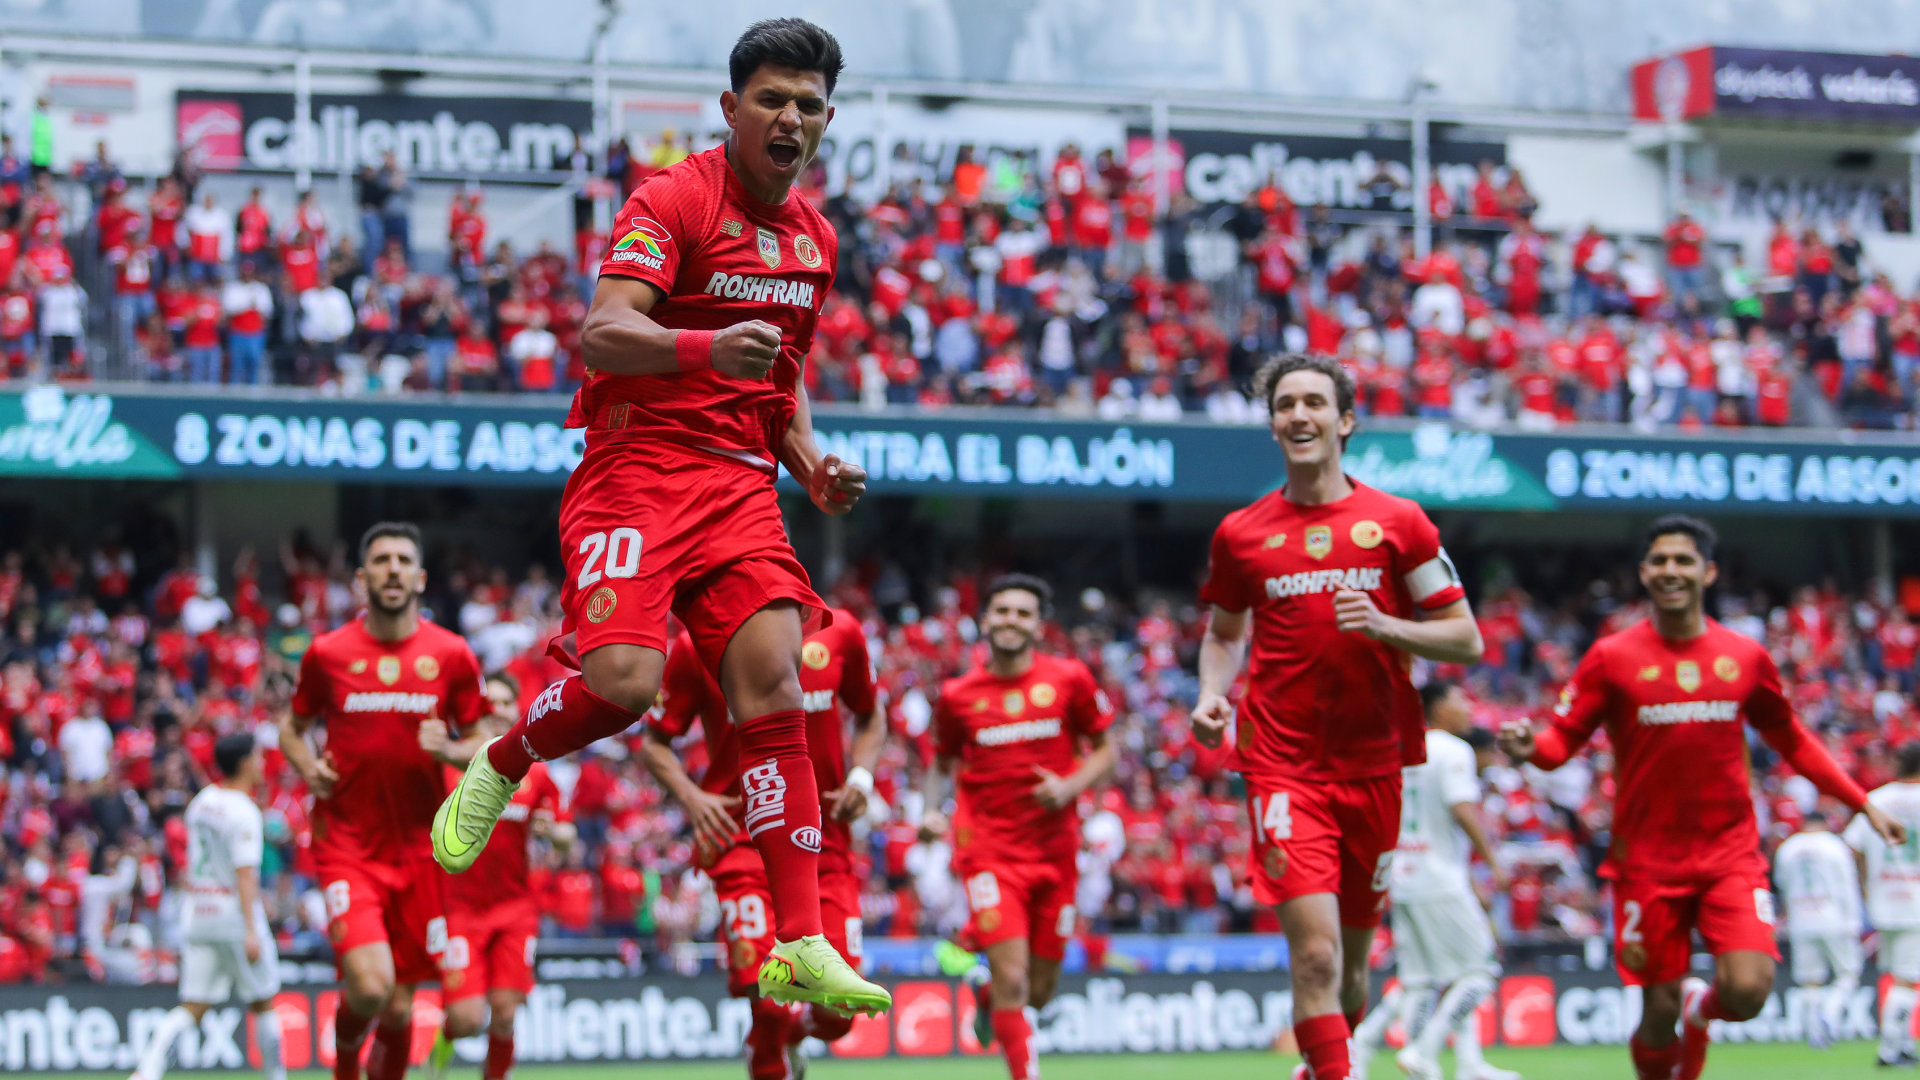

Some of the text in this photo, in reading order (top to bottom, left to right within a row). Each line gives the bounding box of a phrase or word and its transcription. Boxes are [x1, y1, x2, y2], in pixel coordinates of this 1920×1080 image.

[174, 413, 209, 465] 8
[216, 414, 386, 469] ZONAS
[393, 419, 461, 471] DE
[956, 433, 1012, 483] EL
[1016, 427, 1174, 487] BAJÓN
[1546, 449, 1920, 504] 8 ZONAS DE ABSO
[578, 527, 643, 590] 20
[1252, 792, 1293, 844] 14
[720, 894, 767, 940] 29
[1621, 900, 1643, 943] 2
